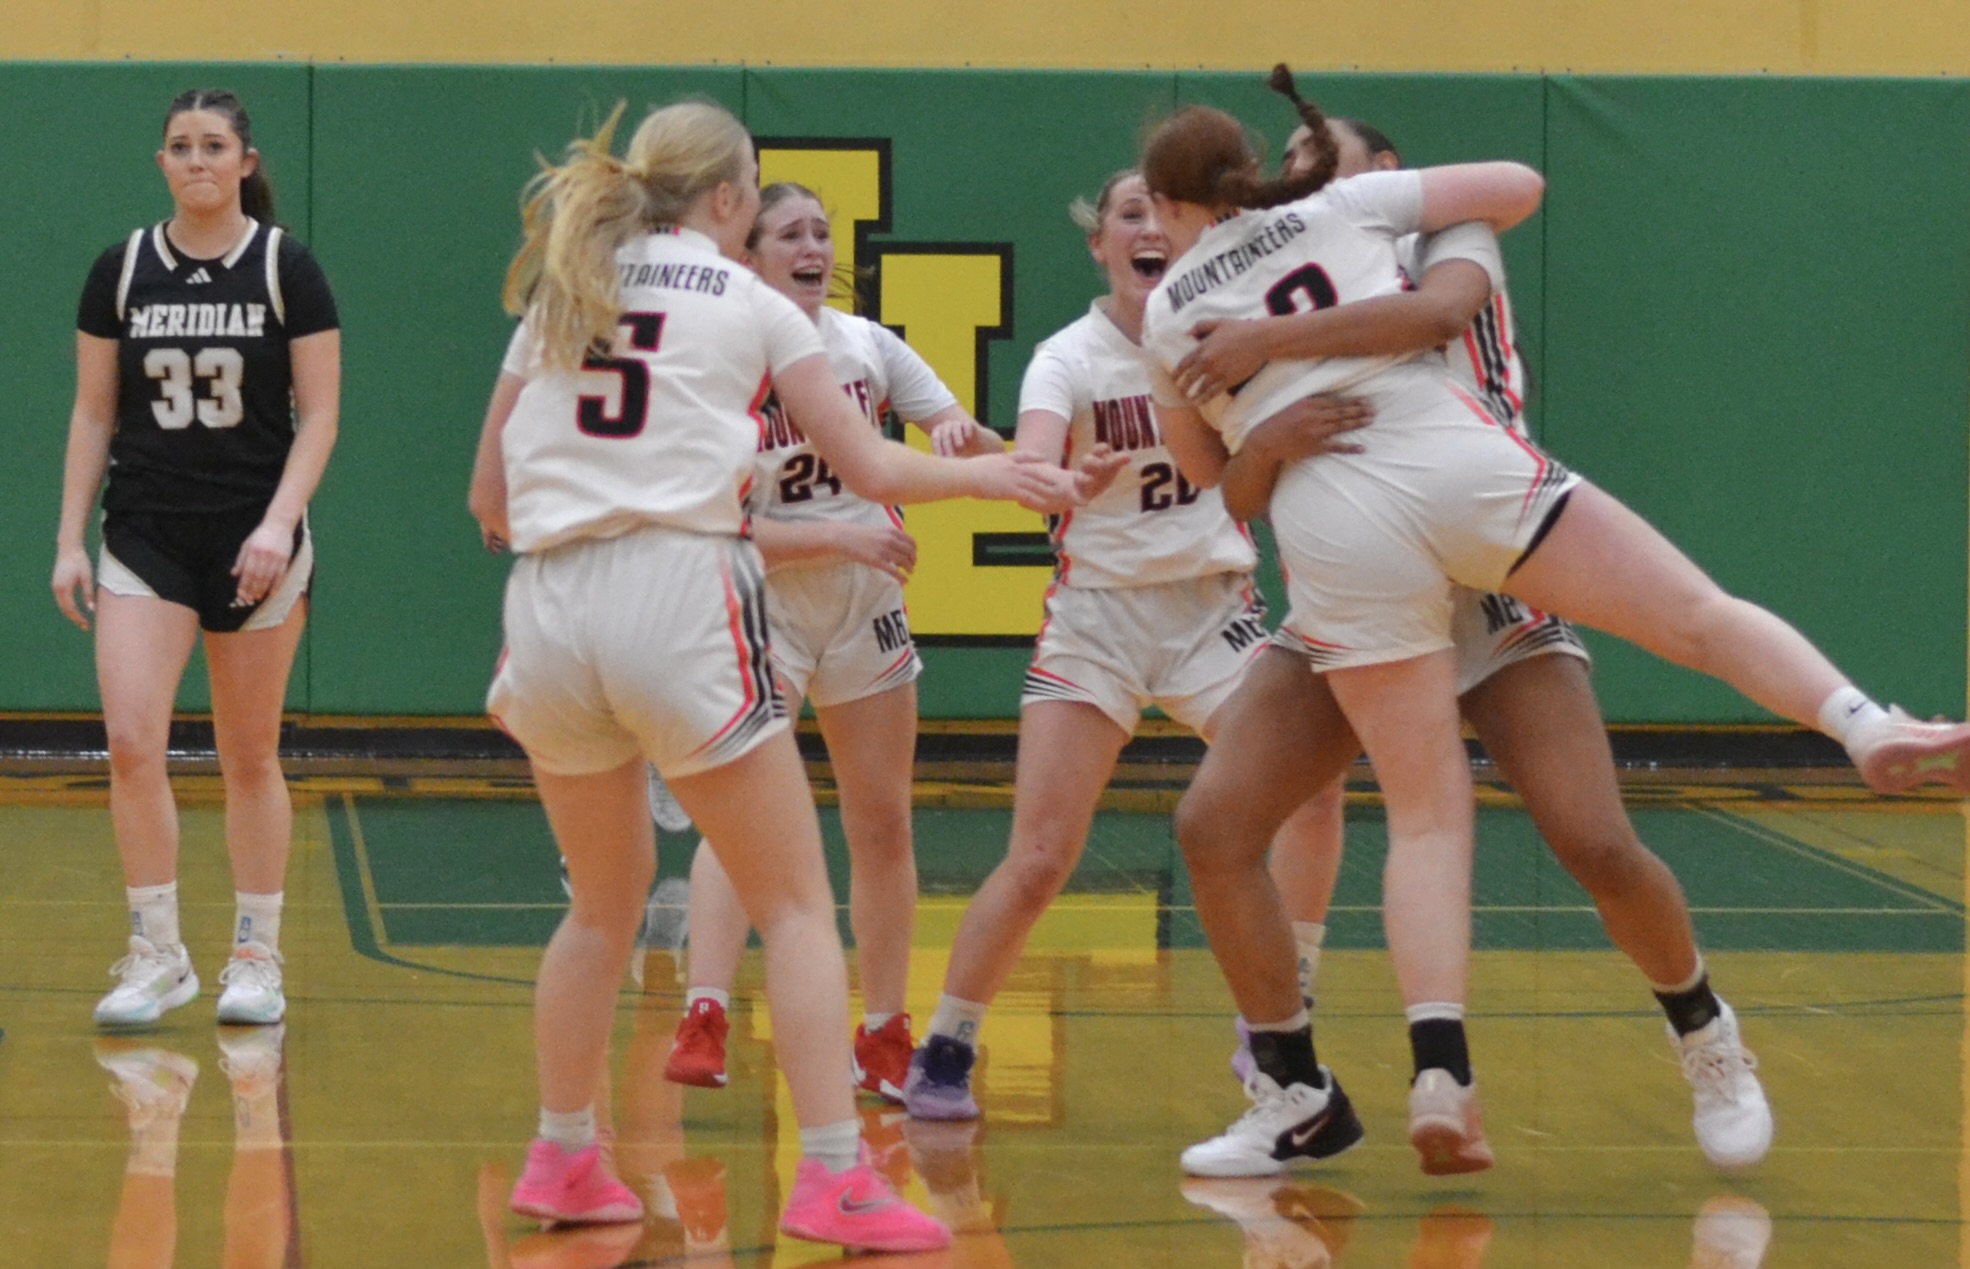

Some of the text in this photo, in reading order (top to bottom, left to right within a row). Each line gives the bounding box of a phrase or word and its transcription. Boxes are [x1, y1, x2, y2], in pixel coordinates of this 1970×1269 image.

[619, 263, 730, 297] TAINEERS
[1167, 212, 1306, 314] MOUNTAINEERS
[143, 347, 244, 430] 33
[576, 311, 668, 440] 5
